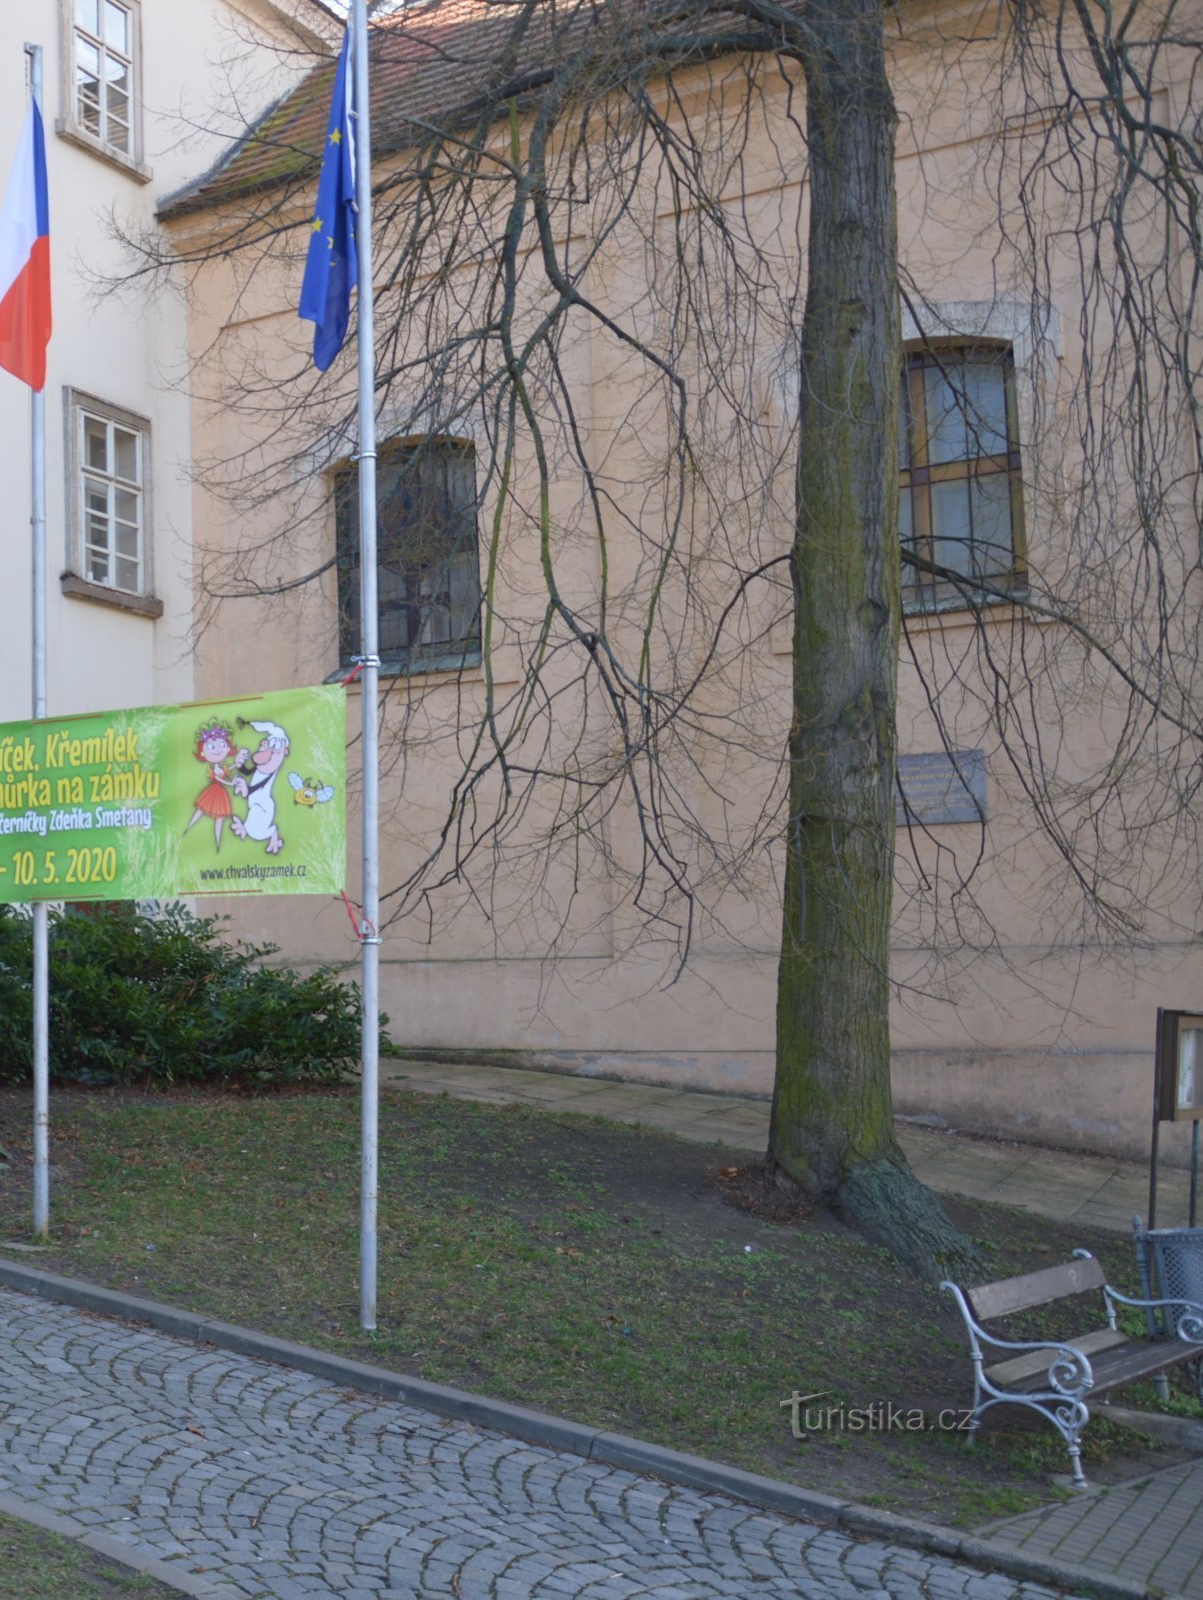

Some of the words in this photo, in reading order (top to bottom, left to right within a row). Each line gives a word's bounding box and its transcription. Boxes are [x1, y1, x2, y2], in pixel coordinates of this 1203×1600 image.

[45, 726, 139, 768] Křemílek
[57, 776, 84, 804] na
[89, 763, 160, 803] zámku
[49, 807, 92, 831] Zdeňka
[95, 806, 152, 829] Smetany
[12, 851, 38, 885] 10.
[43, 851, 60, 884] 5.
[65, 846, 116, 883] 2020
[200, 863, 306, 880] www.chvalskyzamek.cz
